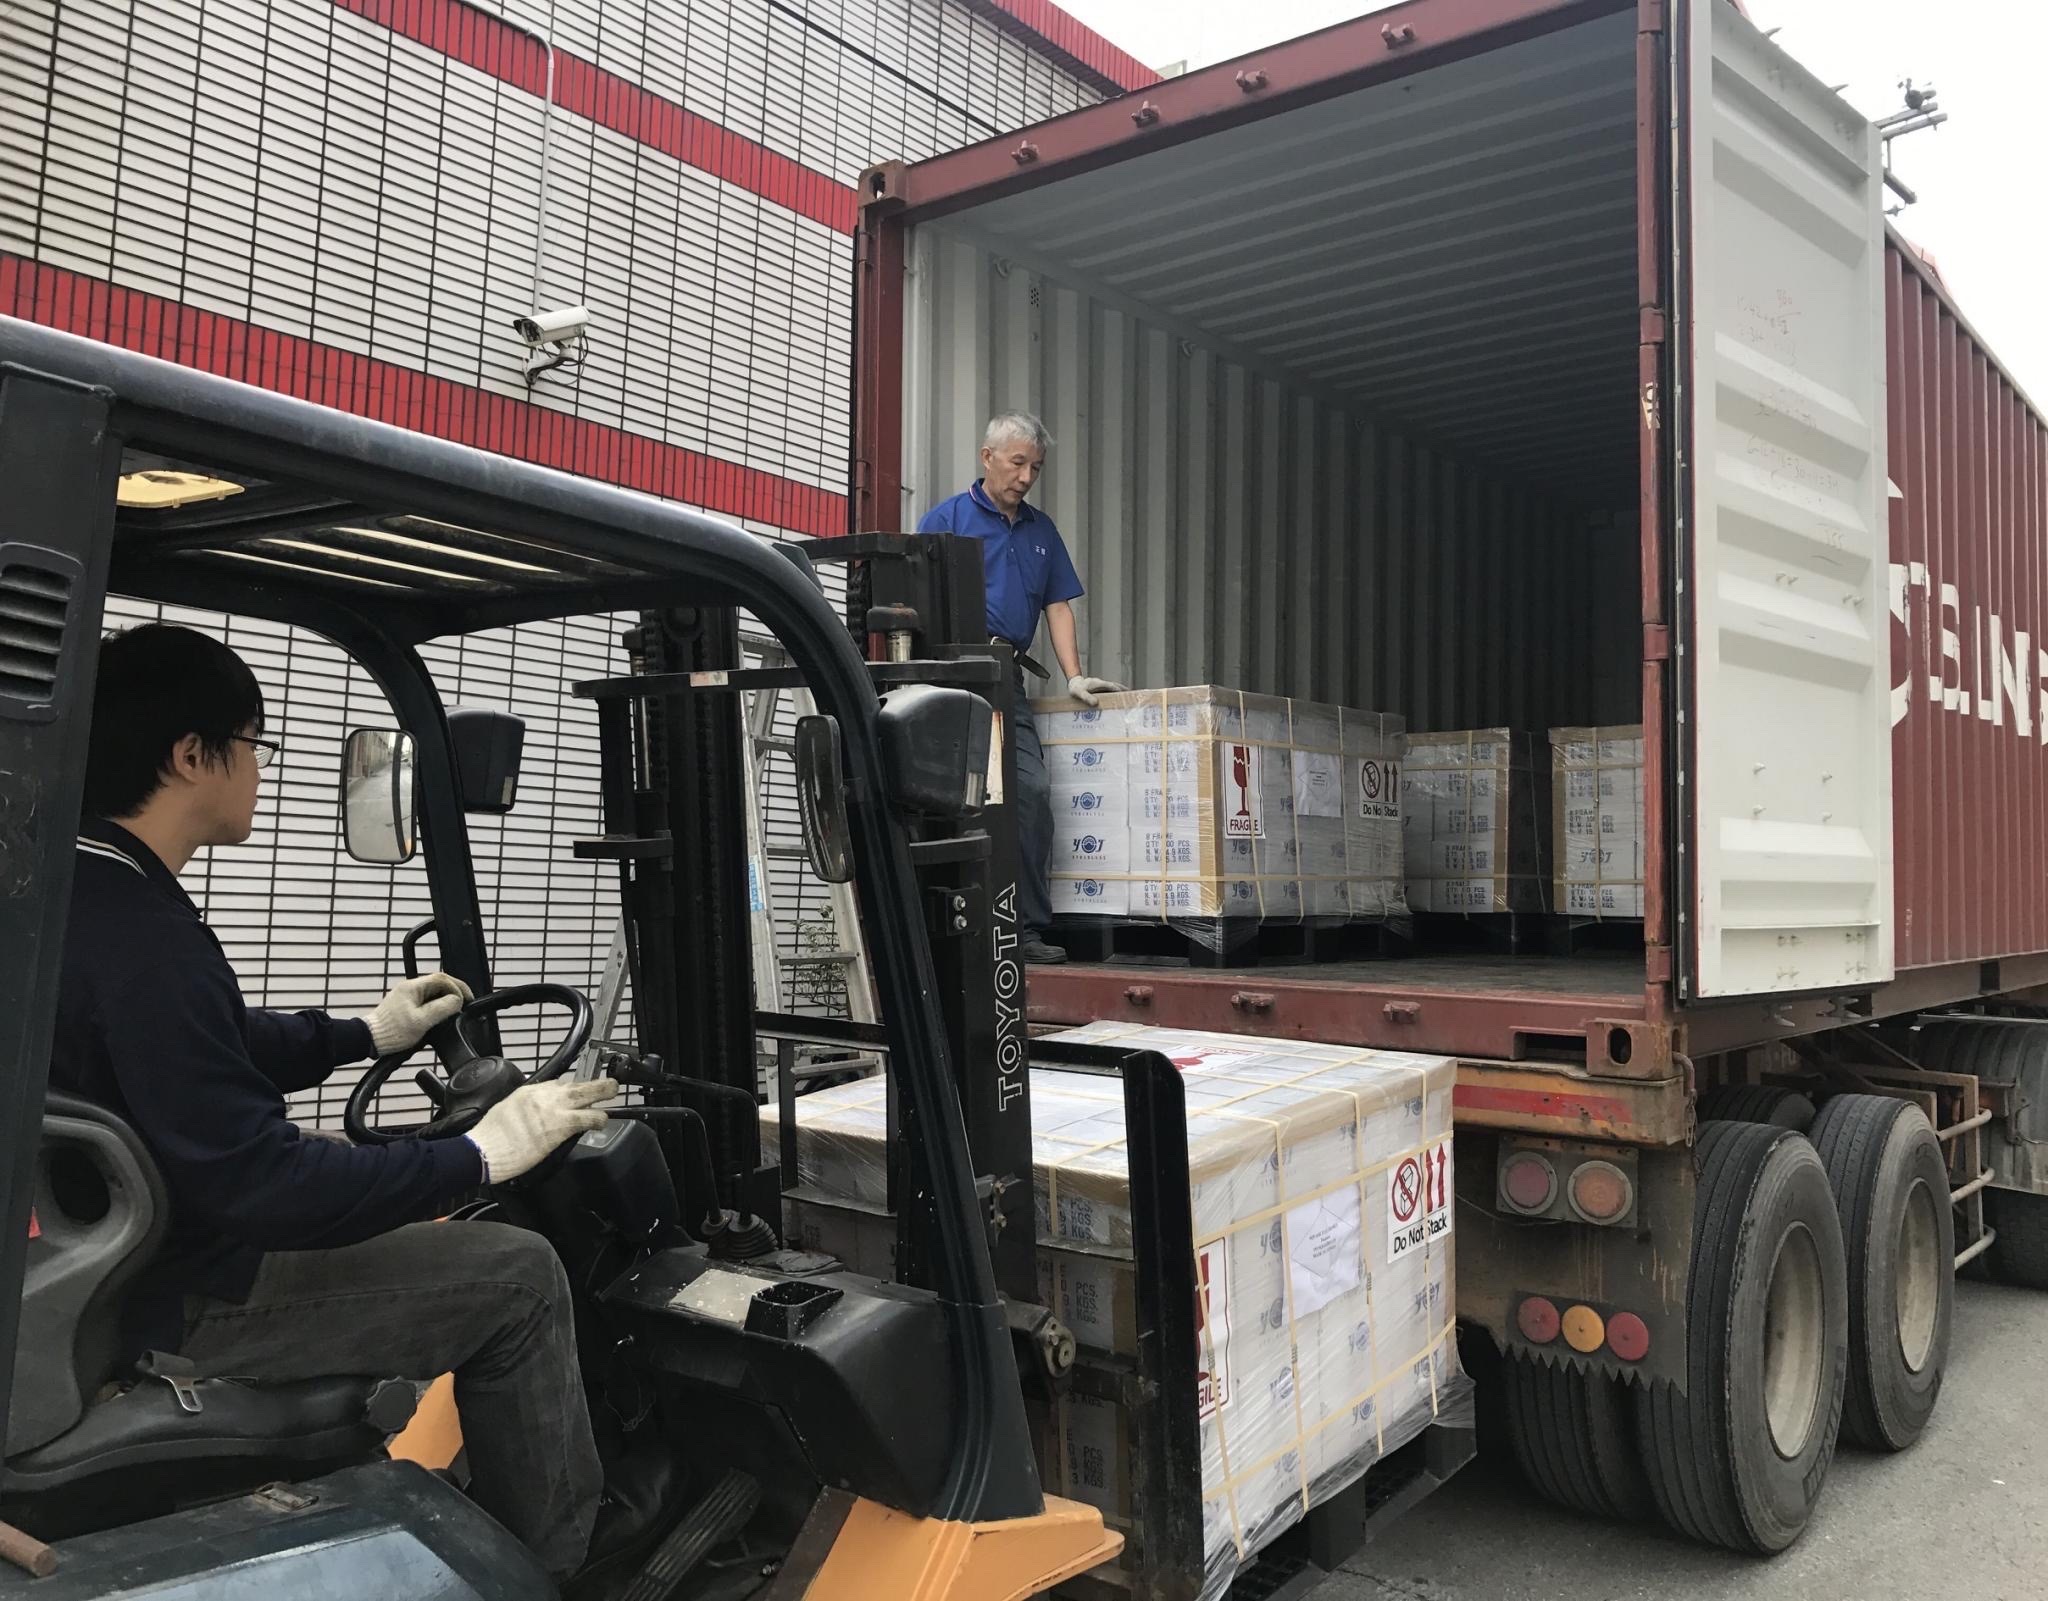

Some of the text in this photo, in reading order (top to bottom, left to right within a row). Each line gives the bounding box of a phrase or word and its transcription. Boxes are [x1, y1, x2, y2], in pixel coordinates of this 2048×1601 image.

[1363, 804, 1372, 815] Do
[992, 881, 1022, 1112] TOYOTA
[1393, 1236, 1407, 1254] Do
[1408, 1225, 1424, 1247] Not
